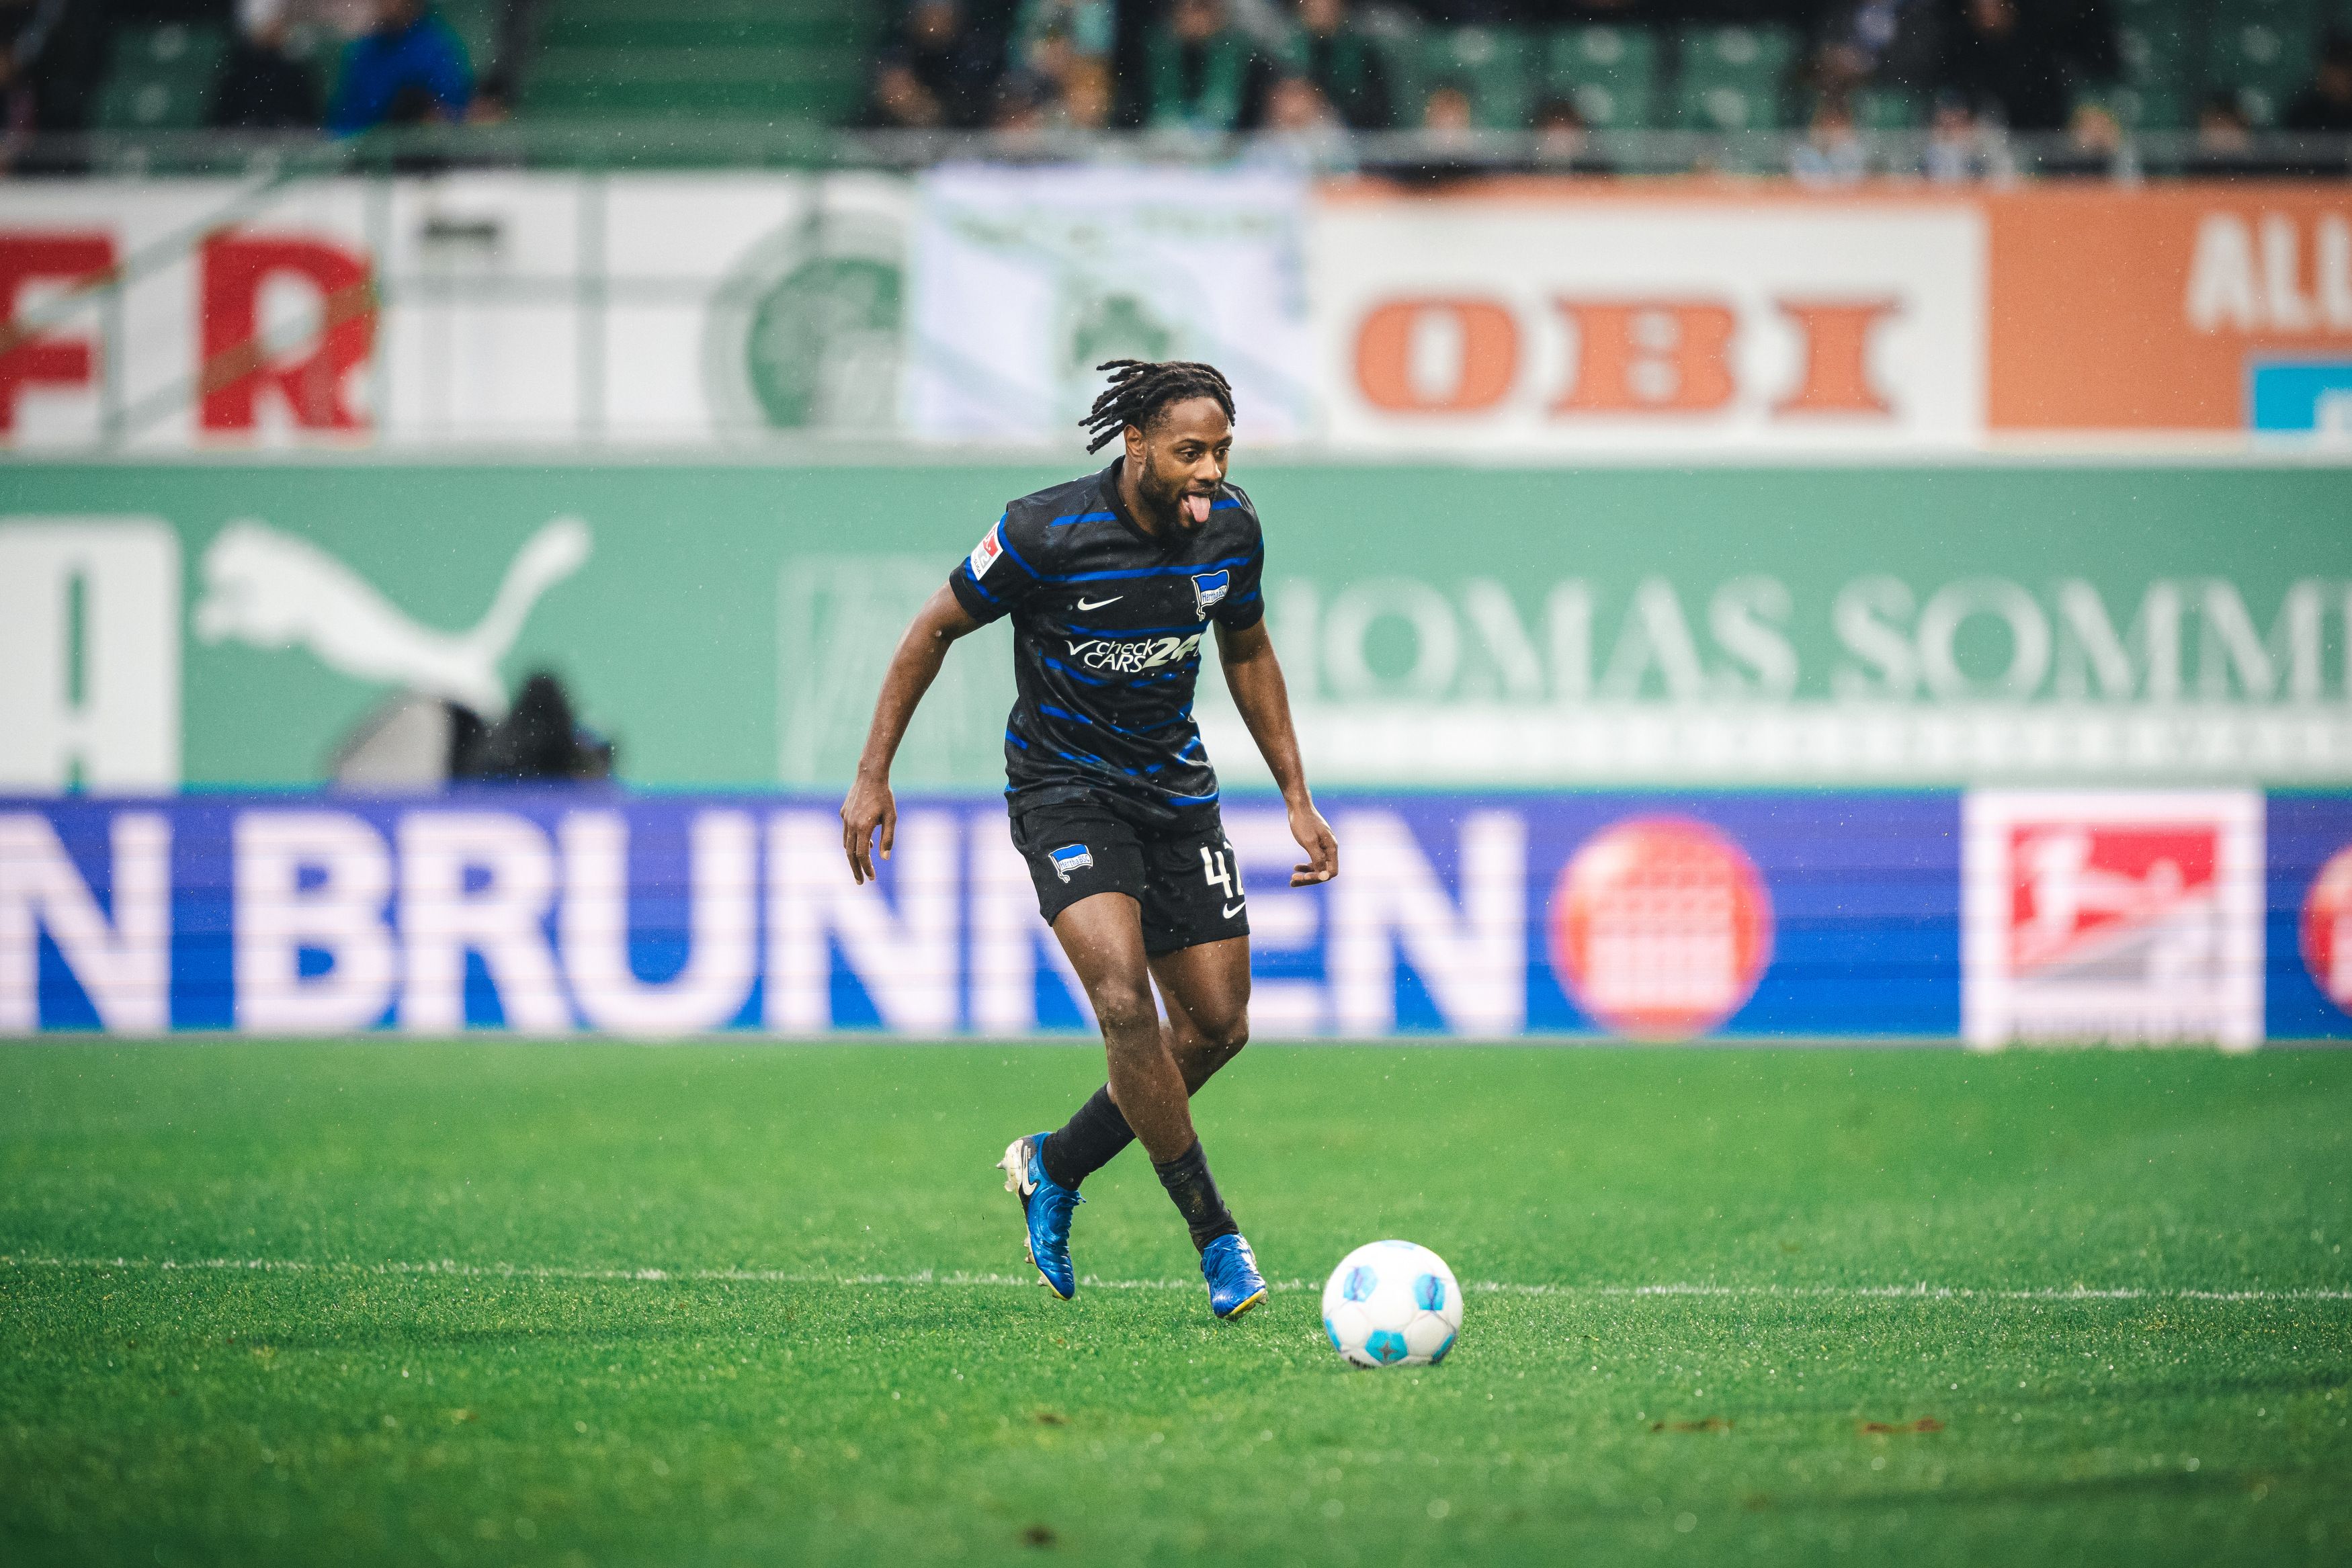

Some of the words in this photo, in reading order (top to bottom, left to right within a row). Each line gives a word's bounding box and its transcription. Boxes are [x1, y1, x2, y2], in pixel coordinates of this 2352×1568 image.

[1351, 294, 1907, 418] OBI
[1084, 652, 1146, 672] CARS
[1202, 575, 1798, 709] HOMAS
[1831, 575, 2352, 709] SOMM
